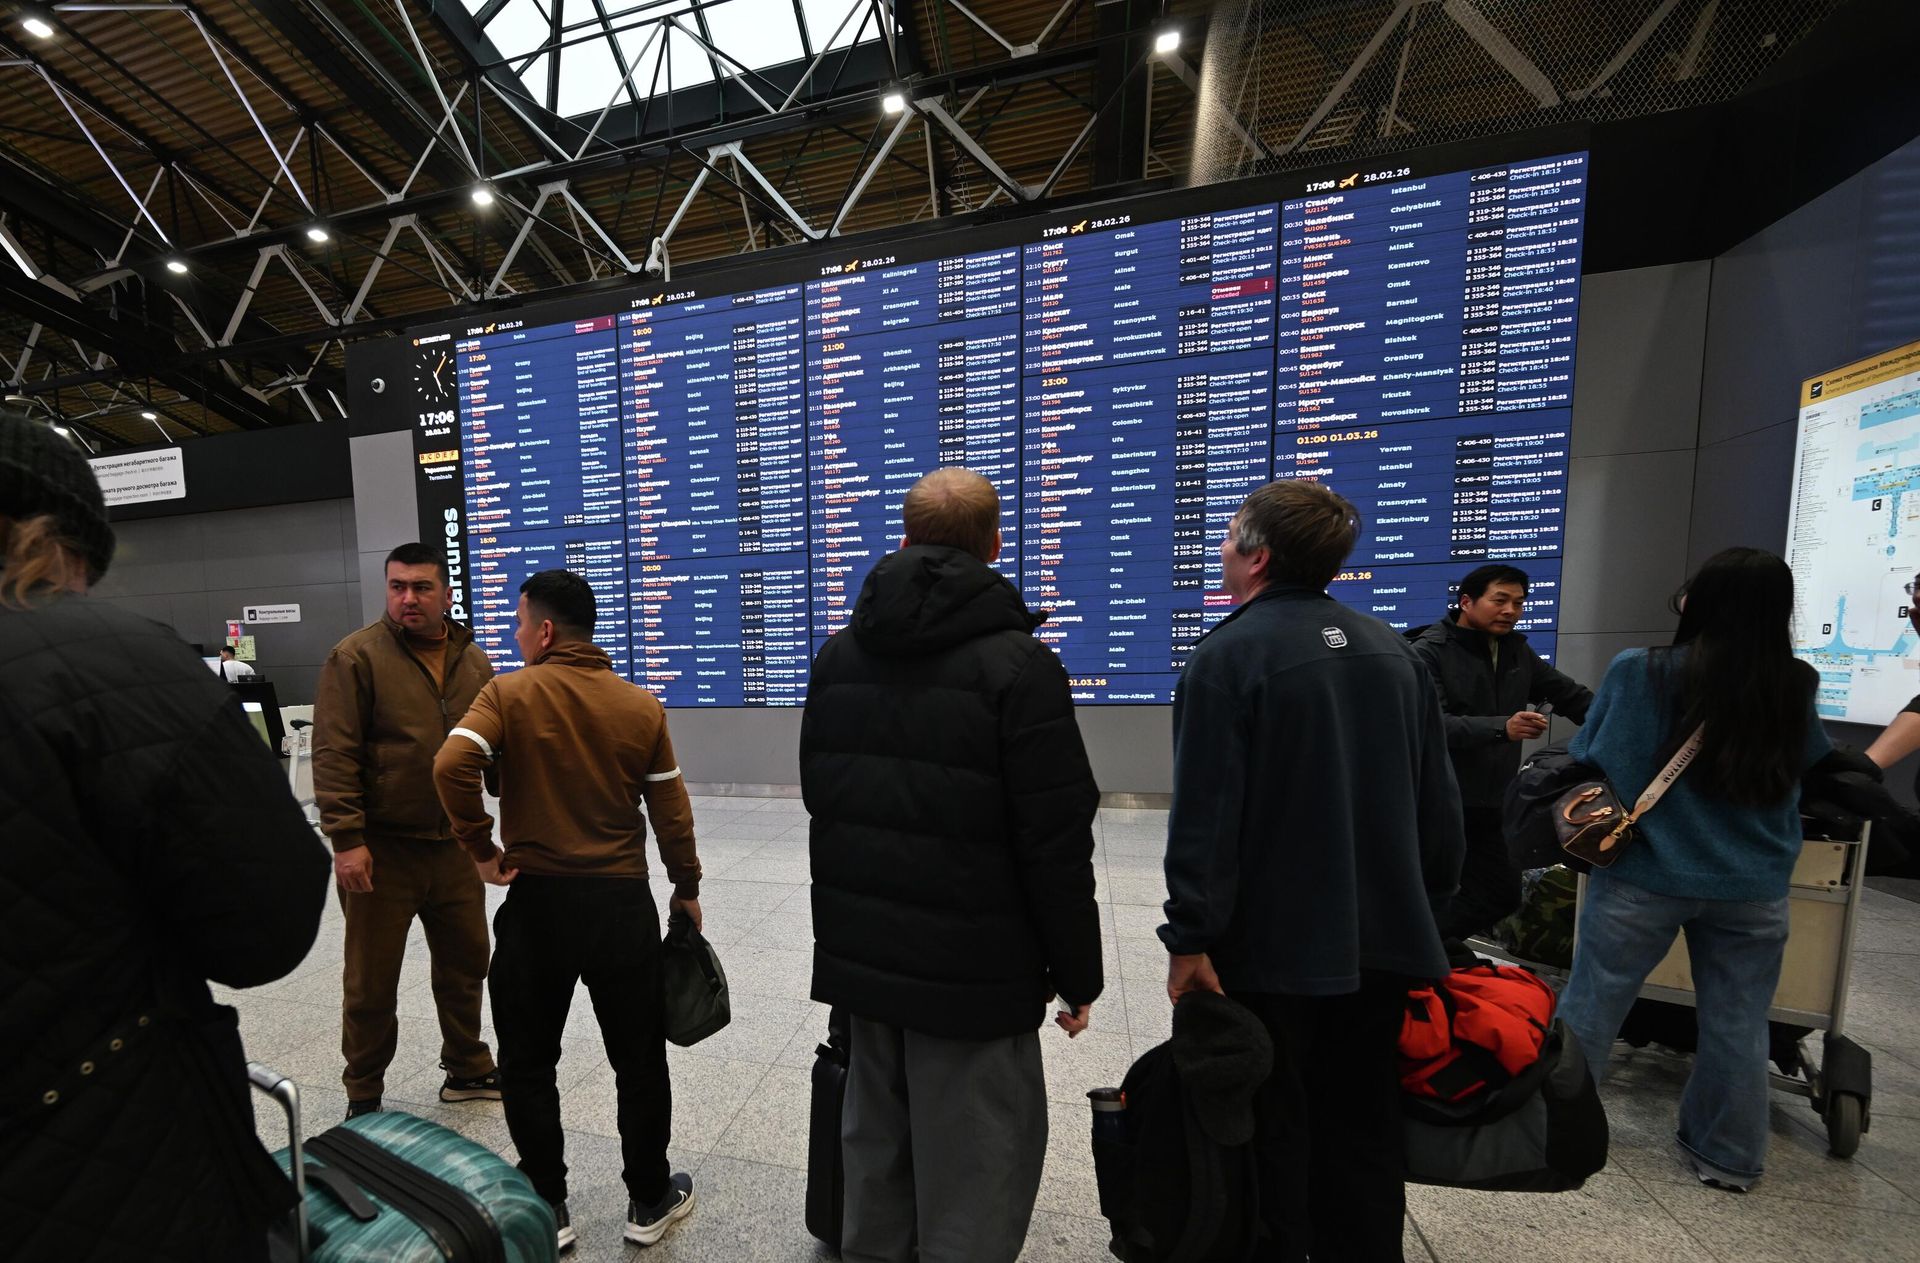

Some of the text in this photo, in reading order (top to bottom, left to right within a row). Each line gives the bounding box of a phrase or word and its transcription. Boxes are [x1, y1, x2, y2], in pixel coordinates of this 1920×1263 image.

[1563, 158, 1582, 166] 18:15
[1477, 170, 1506, 179] 406-430
[1509, 171, 1539, 180] Check-in
[1306, 167, 1411, 193] 17:06 28.02.26
[1391, 183, 1425, 194] Istanbul
[1477, 186, 1505, 196] 319-346
[1477, 193, 1505, 202] 355-364
[1508, 191, 1538, 200] Check-in
[1390, 200, 1441, 213] Chelyabinsk
[1043, 215, 1131, 238] 17:06 28.02.26
[1389, 222, 1422, 232] Tyumen
[1388, 242, 1414, 250] Minsk
[1114, 248, 1138, 256] Surgut
[821, 256, 896, 276] 17:06 28.02.26
[1388, 259, 1429, 269] Kemerovo
[882, 268, 917, 278] Kaliningrad
[1114, 266, 1135, 274] Minsk
[1387, 280, 1410, 288] Omsk
[1211, 291, 1239, 299] Cancelled
[632, 298, 650, 308] 17:06
[1114, 300, 1139, 308] Muscat
[1386, 297, 1417, 306] Barnaul
[883, 317, 909, 325] Belgrade
[1113, 314, 1156, 325] Krasnoyarsk
[1385, 313, 1443, 325] Magnitogorsk
[1113, 331, 1162, 342] Novokuznetsk
[1384, 334, 1416, 343] Bishkek
[822, 342, 844, 352] 21:00
[1113, 347, 1166, 359] Nizhnevartovsk
[1384, 353, 1423, 362] Orenburg
[468, 354, 486, 363] 17:00
[1383, 367, 1453, 380] Khanty-Mansiysk
[1042, 377, 1067, 386] 23:00
[1112, 384, 1146, 393] Syktyvkar
[1382, 390, 1411, 398] Irkutsk
[1112, 400, 1153, 409] Novosibirsk
[1381, 406, 1430, 416] Novosibirsk
[419, 410, 455, 427] 17:06
[1296, 430, 1377, 444] 01:00 01.03.26
[1377, 497, 1427, 506] Krasnoyarsk
[1873, 500, 1880, 510] C
[444, 507, 468, 626] partures
[1372, 604, 1396, 612] Dubai
[1900, 608, 1907, 617] E
